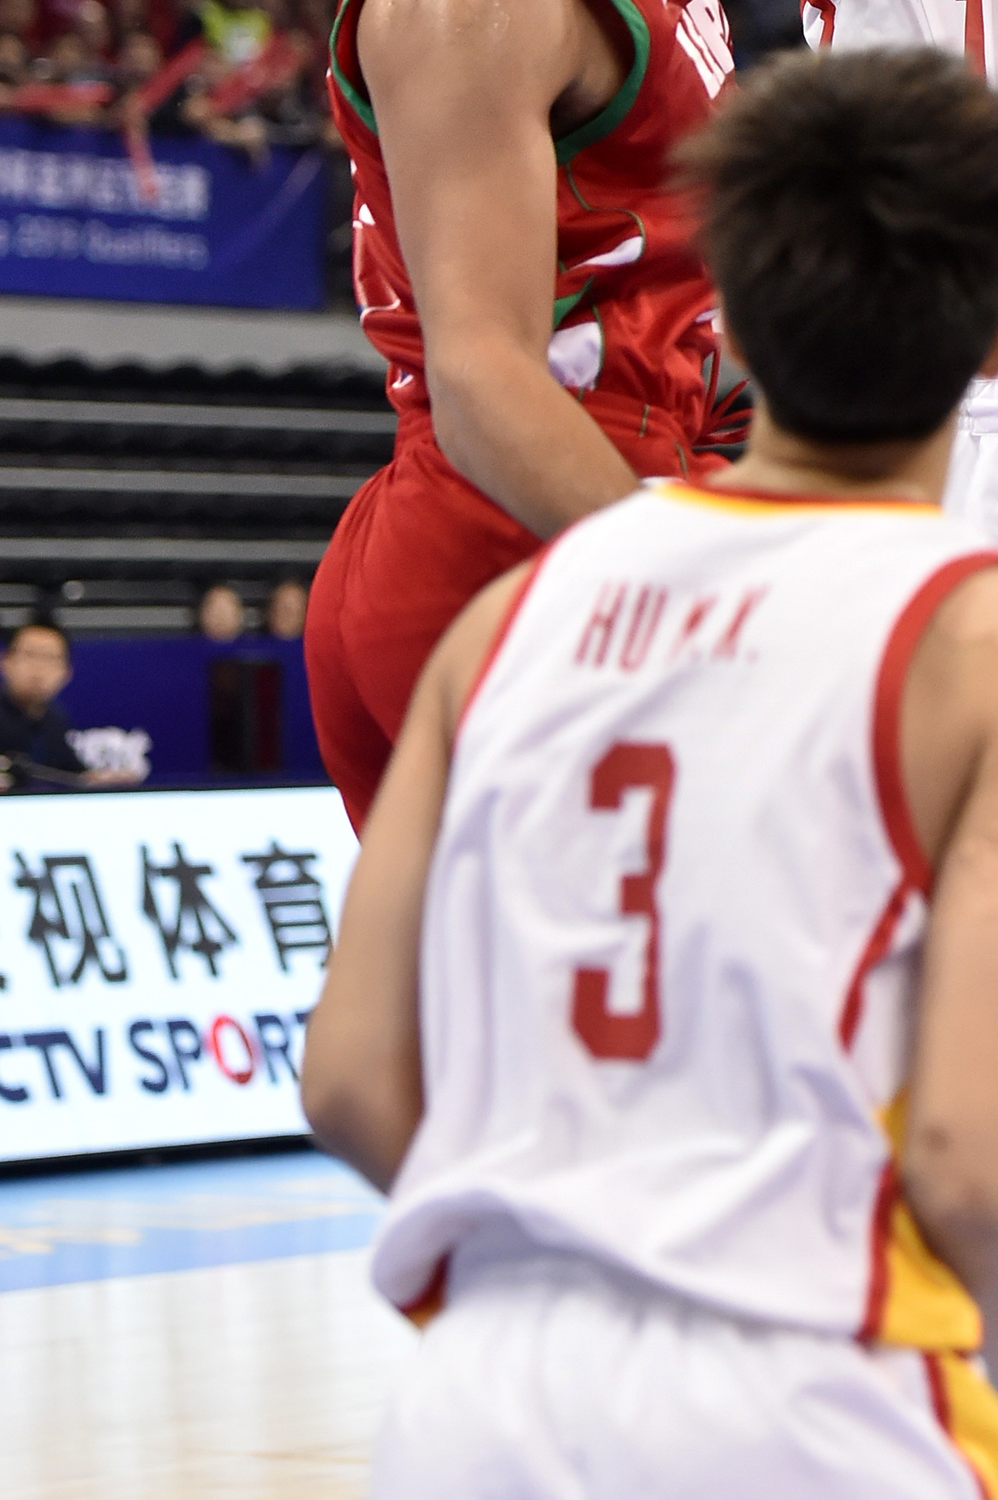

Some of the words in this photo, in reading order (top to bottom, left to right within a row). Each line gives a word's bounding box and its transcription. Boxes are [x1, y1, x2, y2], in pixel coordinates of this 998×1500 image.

[574, 580, 670, 673] HU
[0, 842, 334, 990] 视体育
[570, 741, 676, 1062] 3
[130, 1013, 311, 1093] SPOR
